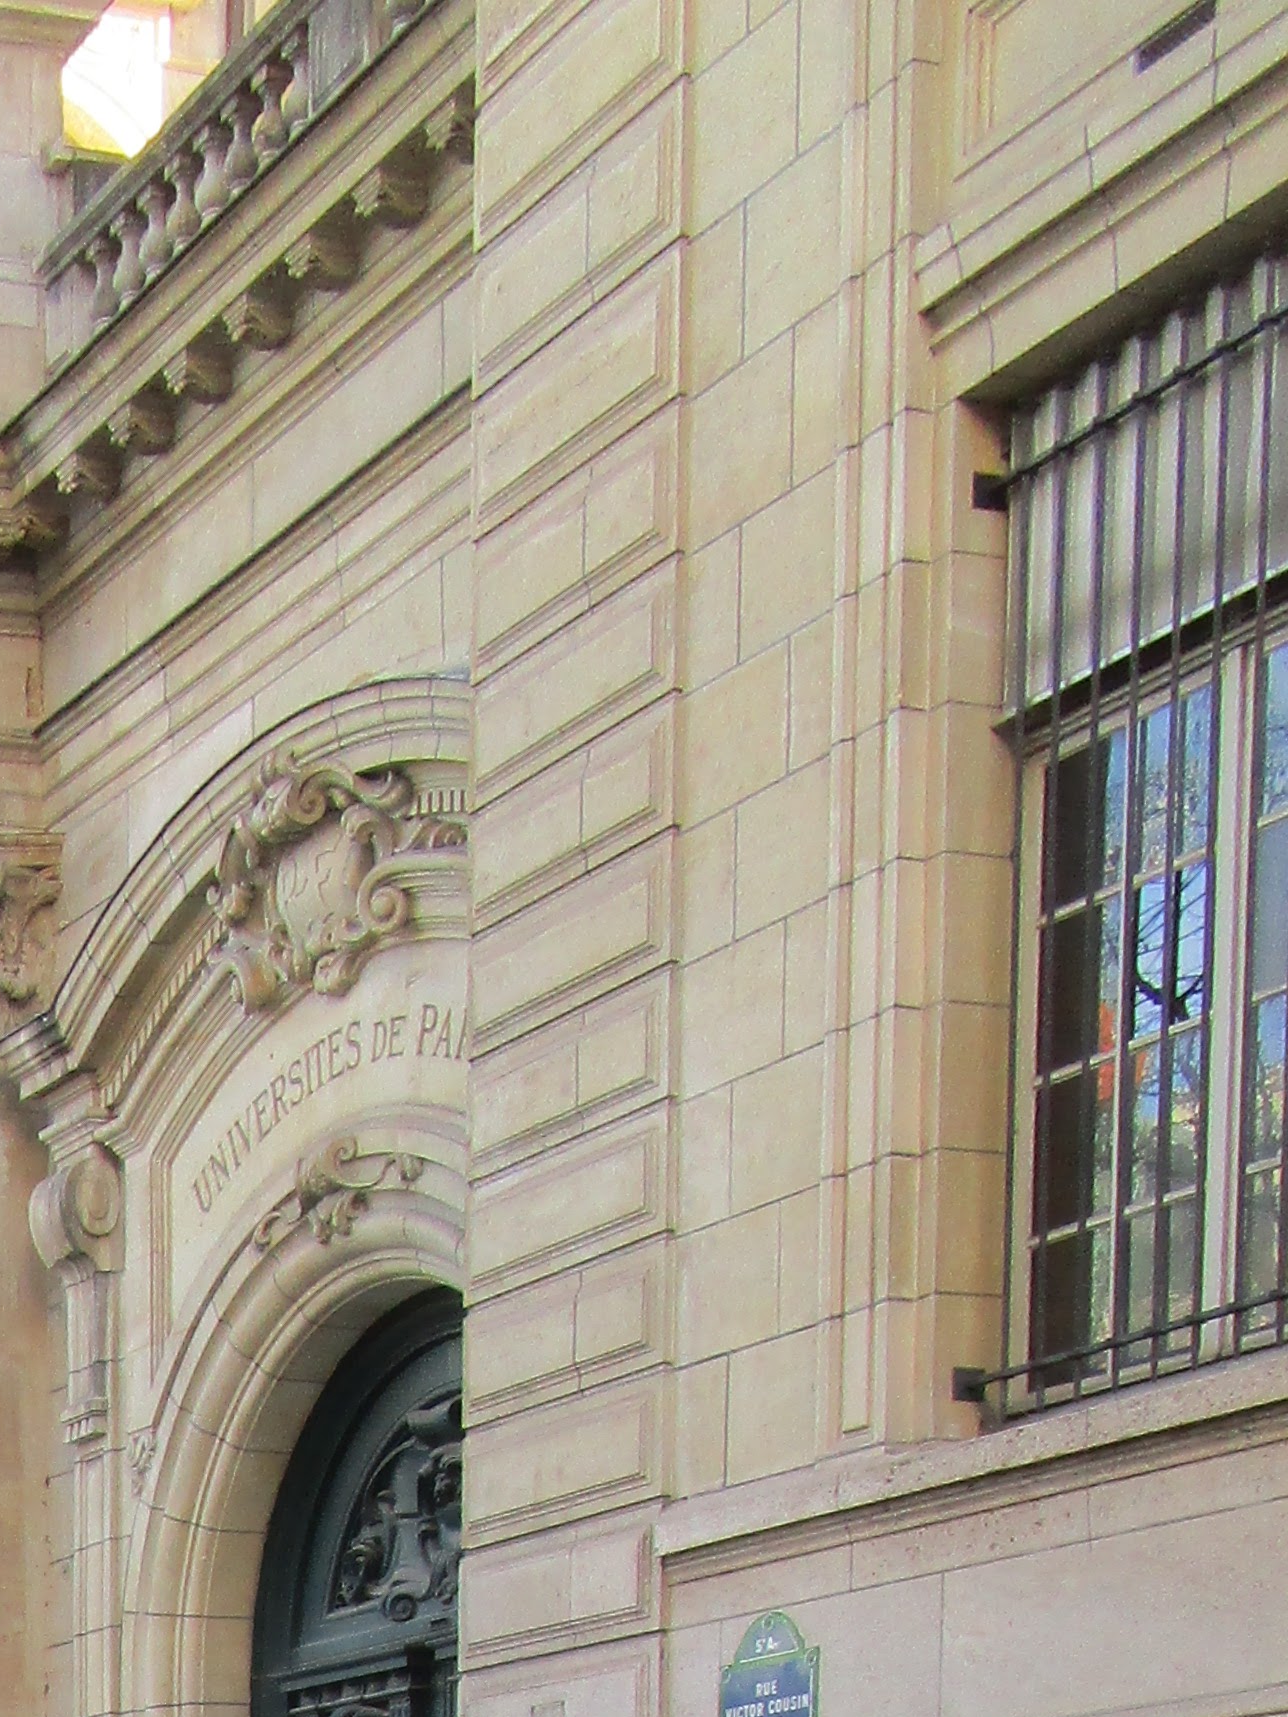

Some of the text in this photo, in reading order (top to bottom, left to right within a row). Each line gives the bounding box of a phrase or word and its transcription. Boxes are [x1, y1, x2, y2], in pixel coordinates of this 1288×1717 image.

[193, 1020, 361, 1213] UNIVERSITES
[371, 1015, 407, 1064] DE
[755, 1679, 777, 1697] RUE
[768, 1693, 809, 1714] COUSIN
